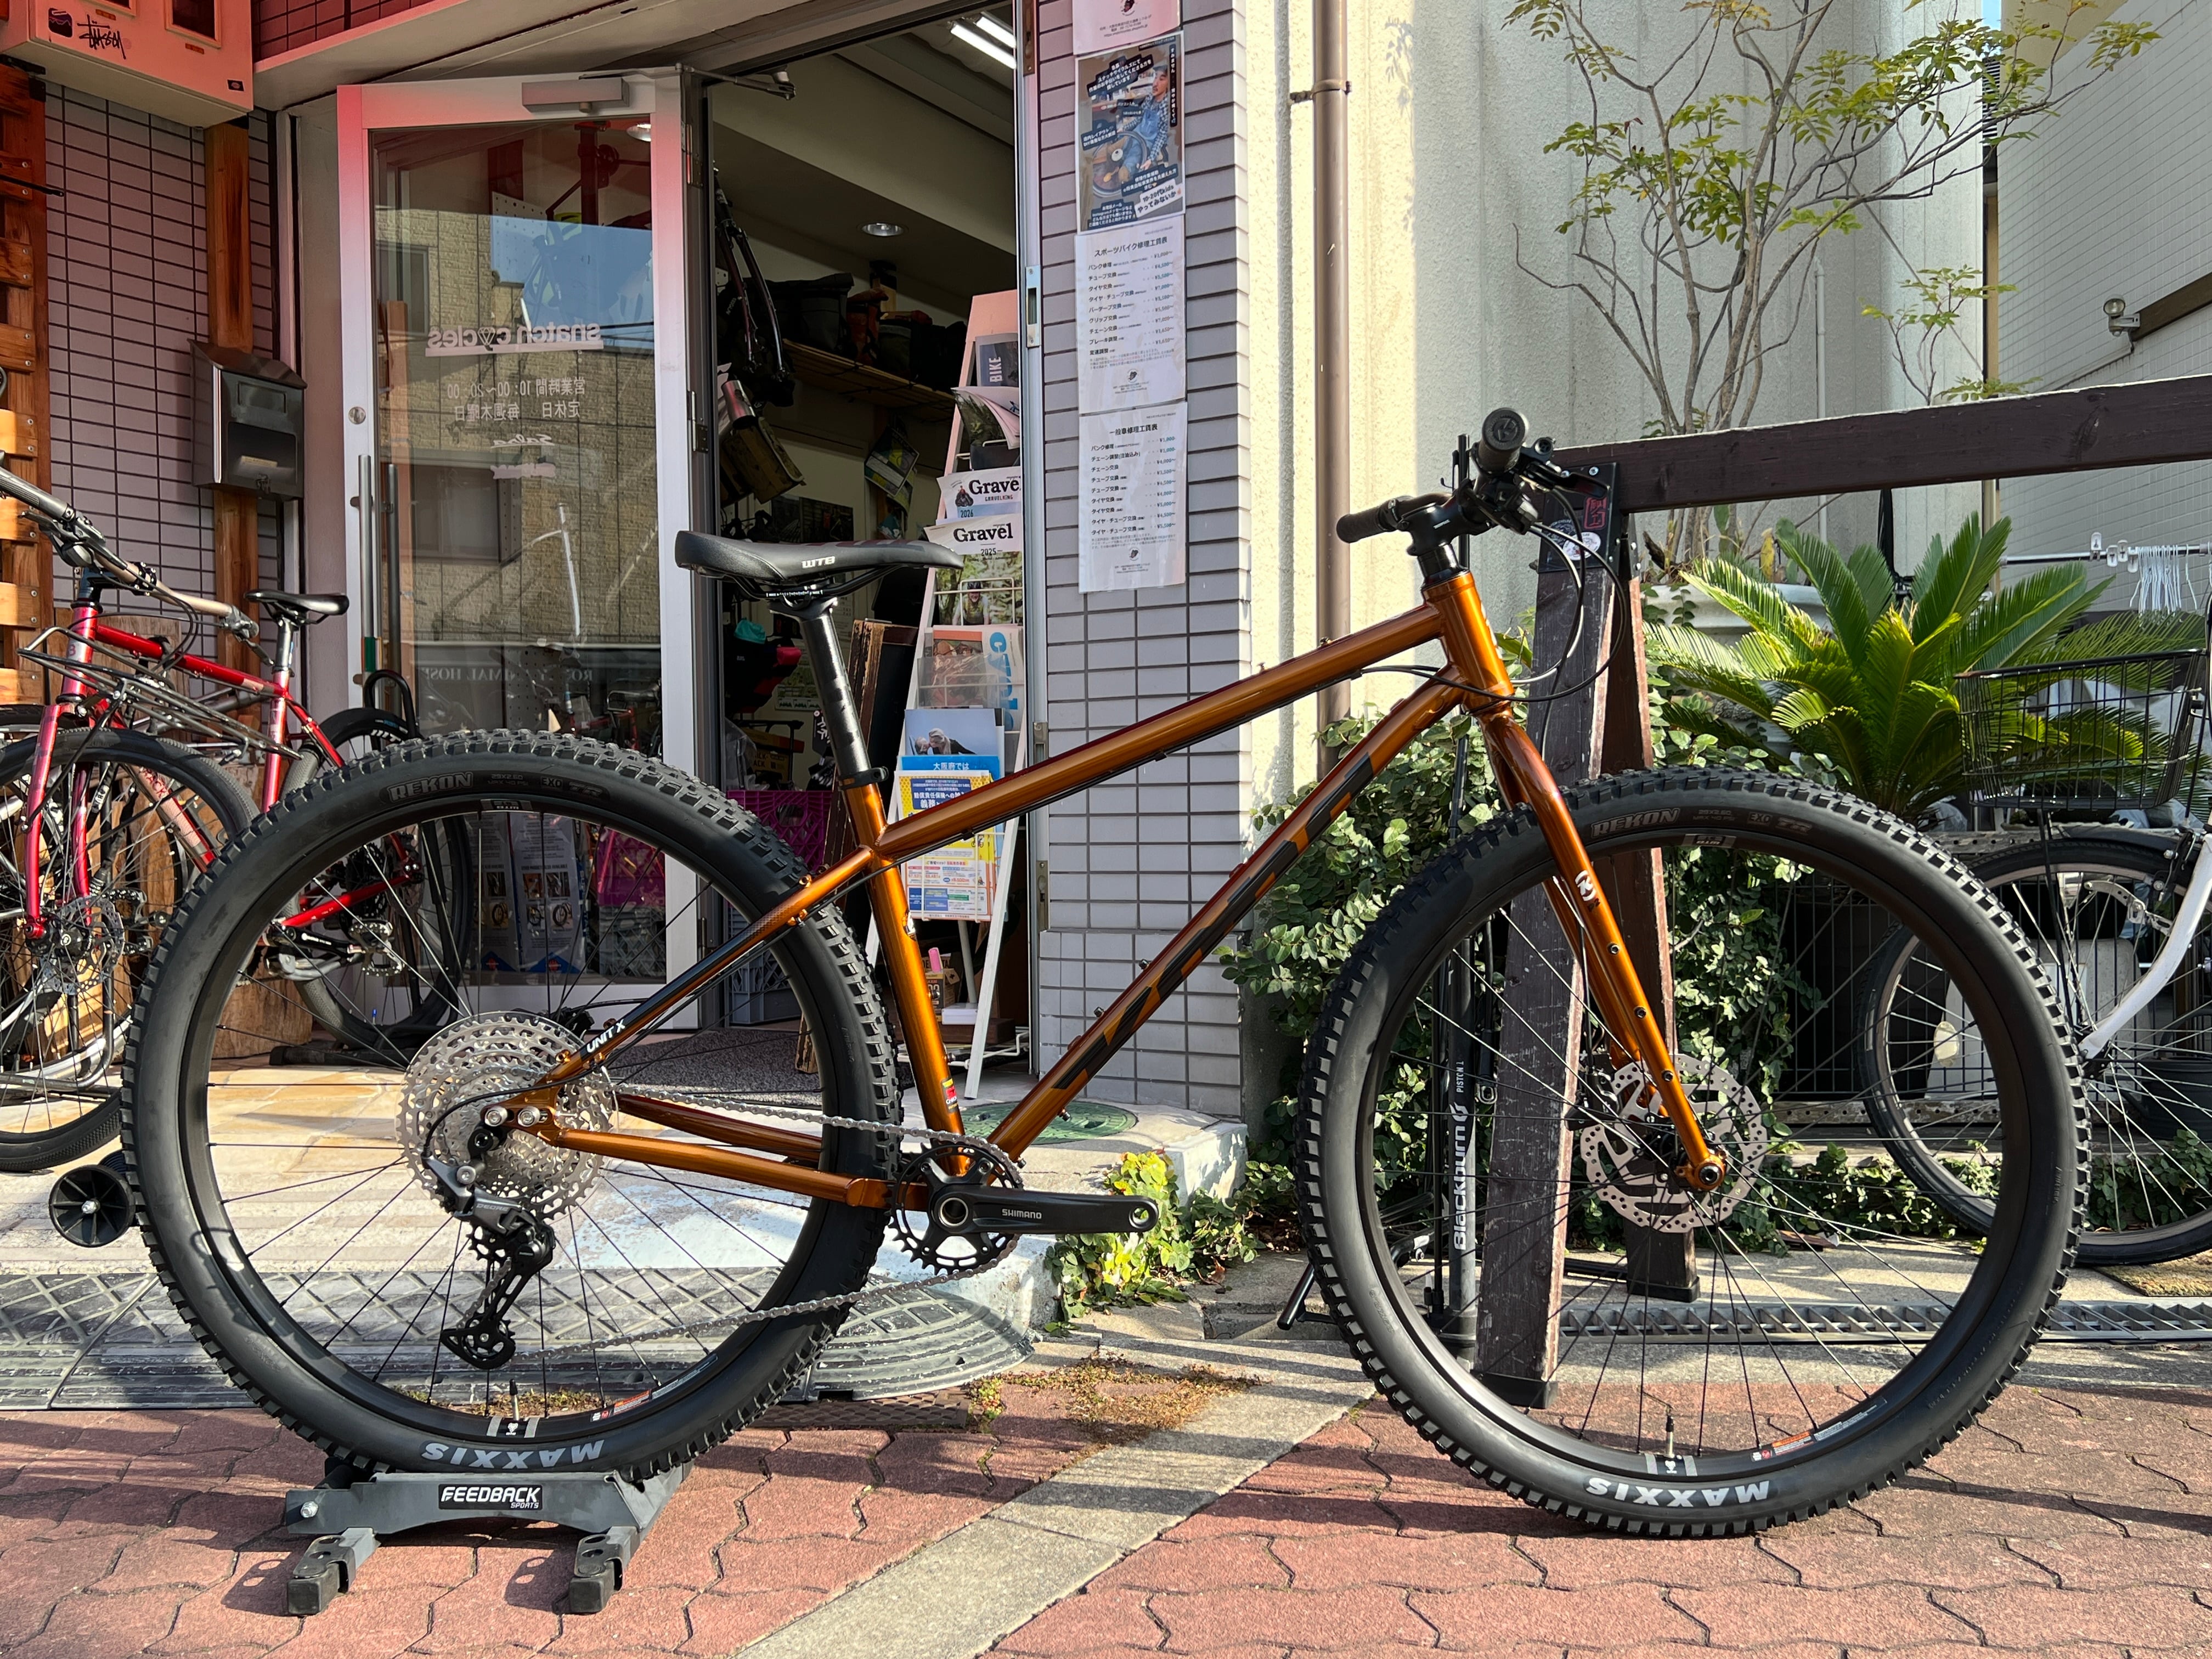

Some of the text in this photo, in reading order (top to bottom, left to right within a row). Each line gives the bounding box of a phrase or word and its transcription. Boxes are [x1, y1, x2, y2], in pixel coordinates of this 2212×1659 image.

[1138, 191, 1176, 213] やってみないか
[1094, 236, 1167, 257] スポーツバイク修理工賃表
[989, 356, 1002, 383] BIKE
[1109, 424, 1158, 436] 一般車修理工賃表
[968, 476, 1021, 495] Grave
[961, 509, 974, 518] 2026
[953, 523, 1013, 543] Gravel
[801, 556, 836, 568] WTB
[933, 762, 969, 770] 大阪府では
[388, 771, 473, 803] REKON
[541, 777, 562, 788] EXO
[1592, 807, 1680, 837] REKON
[1749, 812, 1771, 823] EXO
[586, 1019, 625, 1053] UNIT X
[1453, 1121, 1466, 1251] Blackburn
[476, 1203, 510, 1211] DEORE
[1002, 1209, 1042, 1219] SHIMANO
[421, 1439, 605, 1469] MAXXIS
[441, 1486, 540, 1502] FEEDBACK
[1586, 1477, 1770, 1508] MAXXIS
